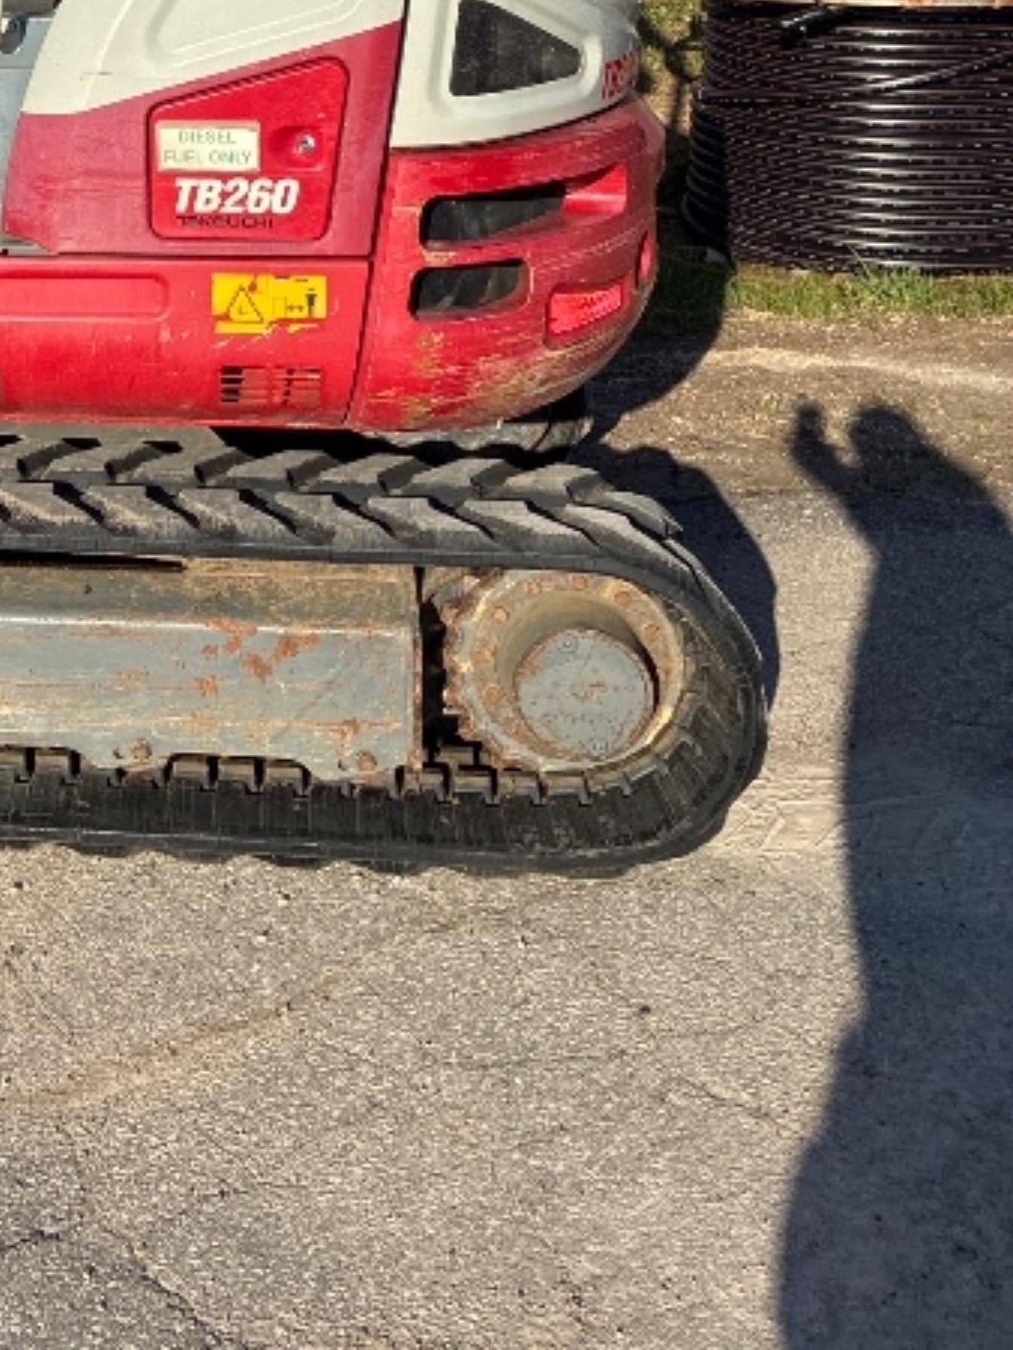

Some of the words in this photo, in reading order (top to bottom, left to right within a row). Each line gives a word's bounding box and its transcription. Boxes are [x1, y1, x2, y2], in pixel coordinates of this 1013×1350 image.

[178, 131, 236, 144] DIESEL
[163, 151, 202, 164] FUEL
[209, 151, 251, 164] ONLY
[175, 178, 300, 214] TB260
